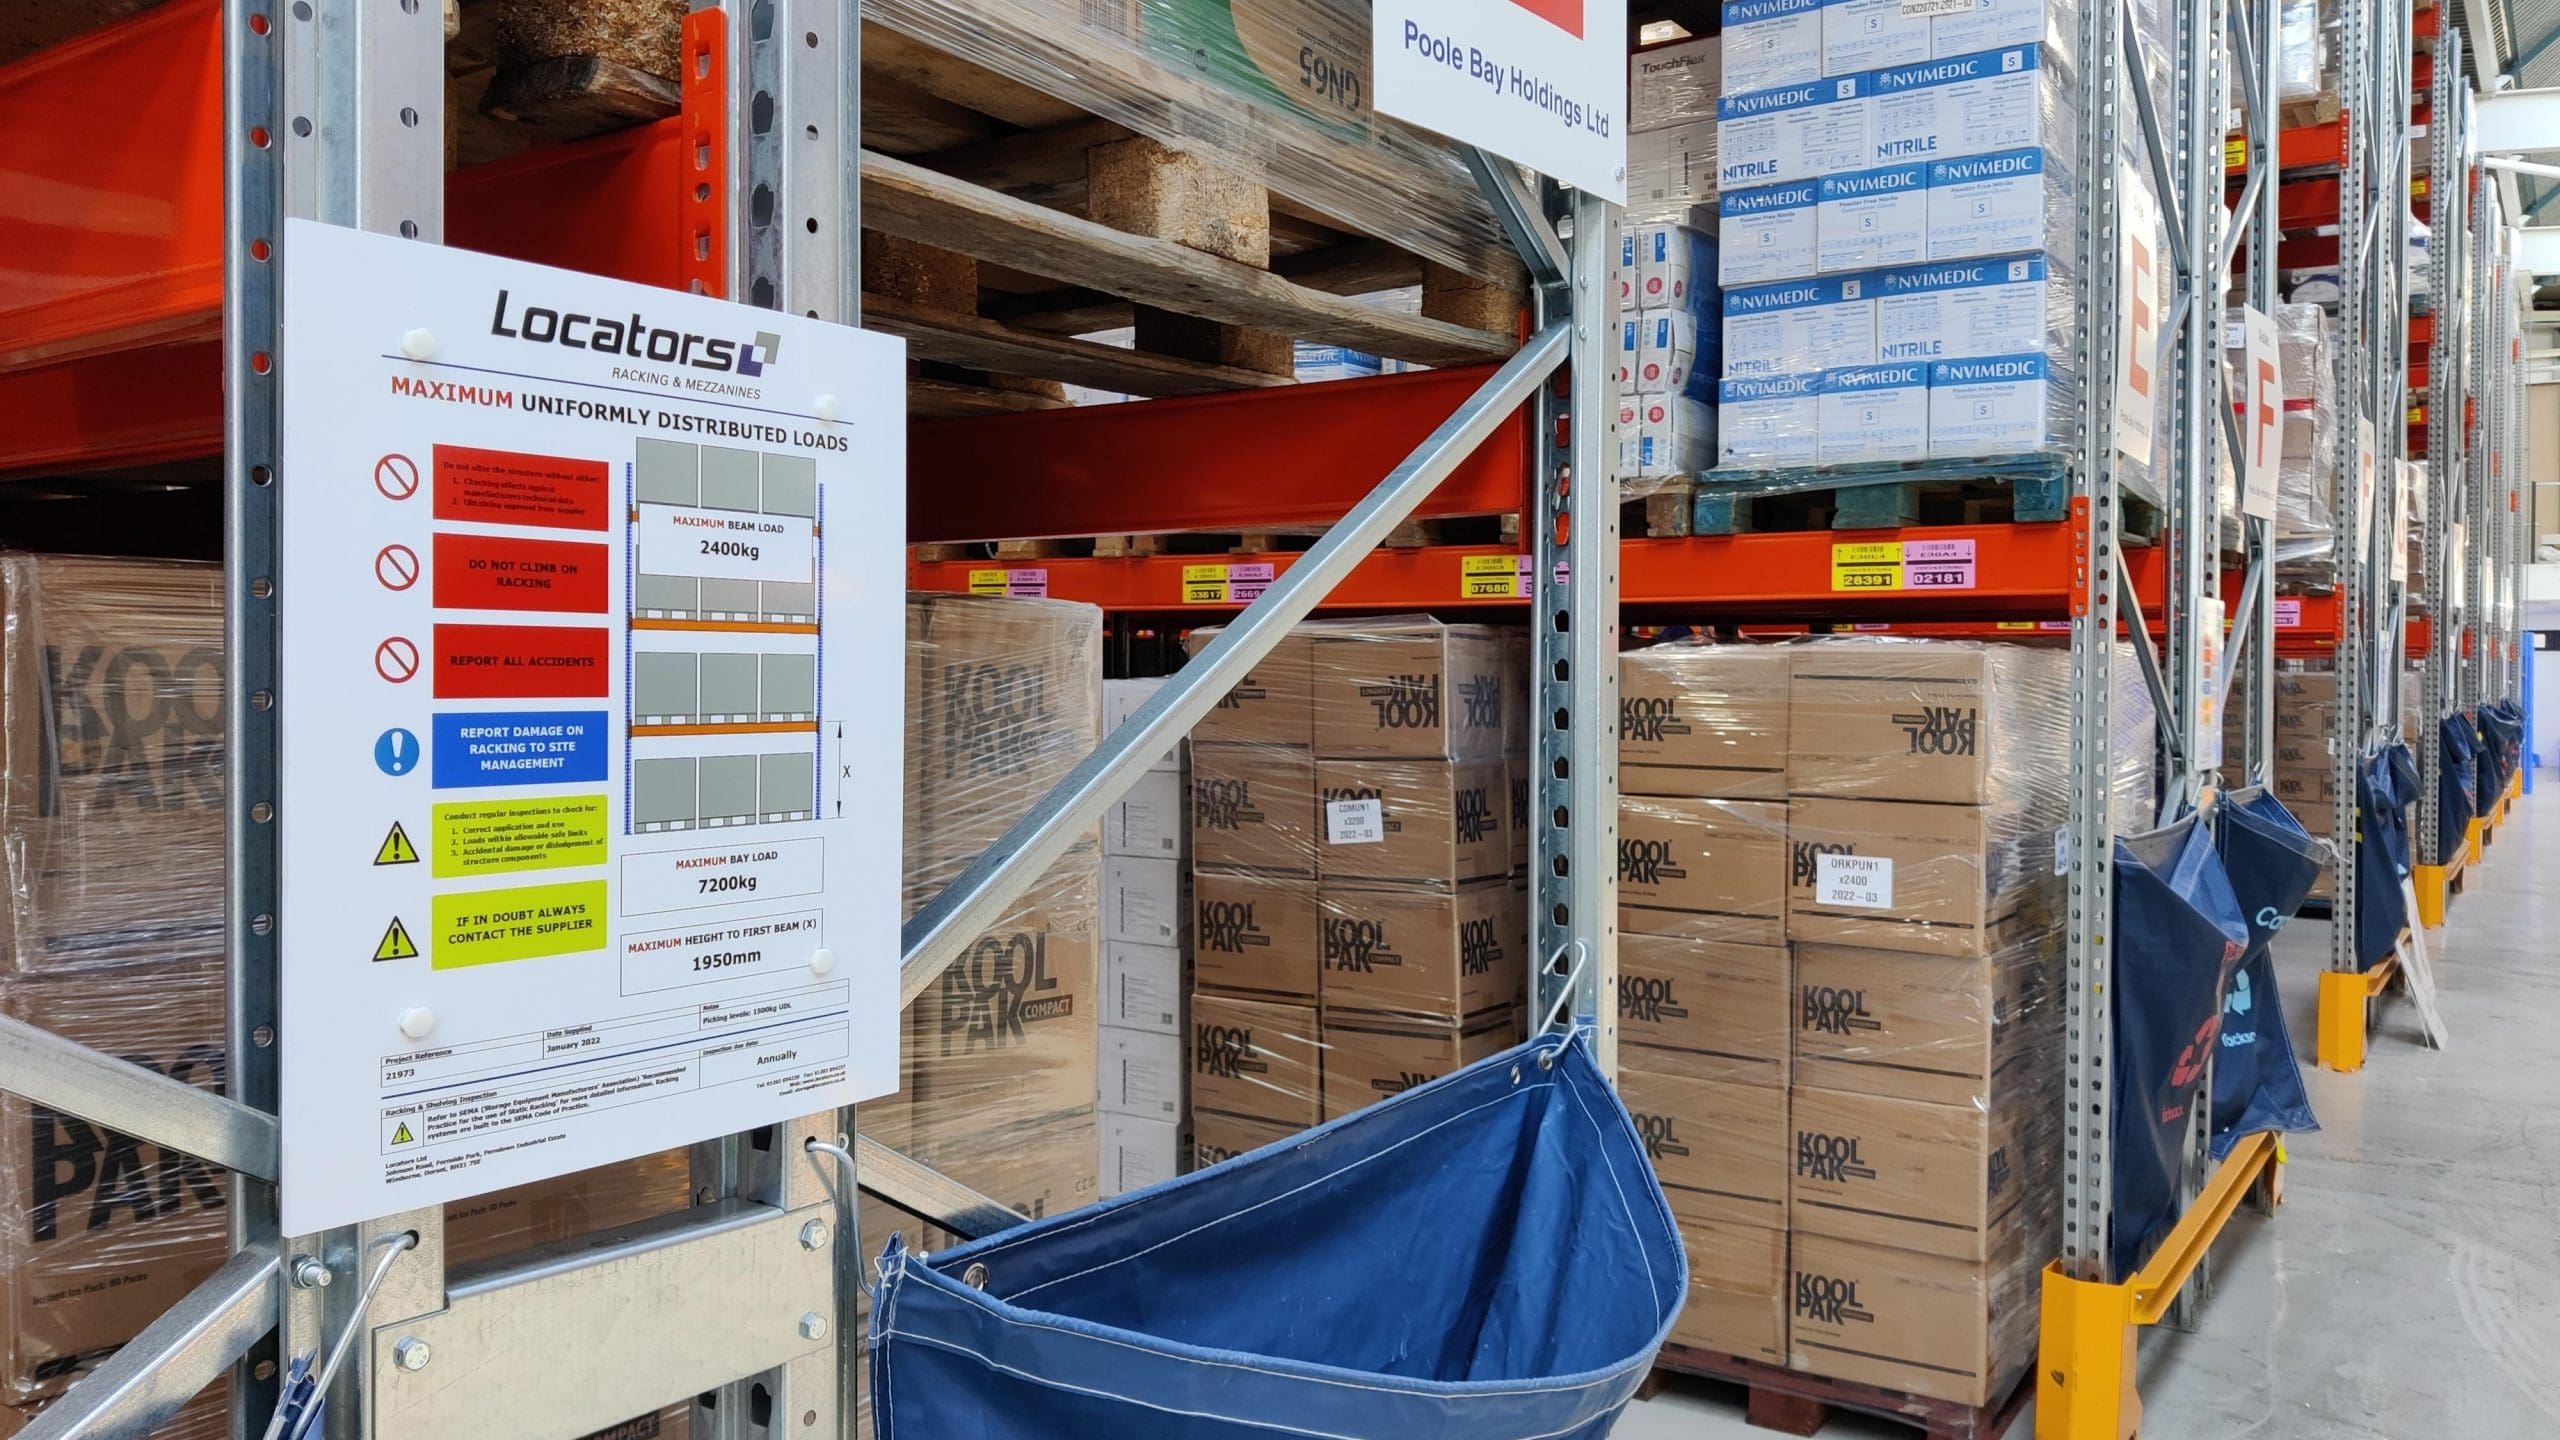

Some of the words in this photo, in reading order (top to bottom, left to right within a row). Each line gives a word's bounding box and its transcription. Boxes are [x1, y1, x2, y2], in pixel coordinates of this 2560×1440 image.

[1641, 53, 1706, 74] TouchFlex
[1893, 60, 1978, 88] NVIMEDIC
[1299, 46, 1360, 112] GN65
[1404, 19, 1463, 70] Poole
[1470, 47, 1504, 94] Bay
[1510, 65, 1581, 127] Holdings
[1587, 103, 1609, 139] Ltd
[1737, 87, 1816, 112] NVIMEDIC
[1877, 135, 1937, 158] NITRILE
[1723, 158, 1778, 181] NITRILE
[1948, 155, 2033, 180] NVIMEDIC
[1836, 171, 1917, 195] NVIMEDIC
[1737, 188, 1813, 211] NVIMEDIC
[1898, 267, 1984, 290] NVIMEDIC
[1742, 287, 1820, 310] NVIMEDIC
[2130, 234, 2149, 398] E
[491, 289, 736, 373] Locators
[1882, 339, 1942, 360] NITRILE
[1838, 367, 1918, 389] NVIMEDIC
[1950, 360, 2035, 381] NVIMEDIC
[612, 366, 668, 386] RACKING
[672, 375, 681, 388] &
[685, 377, 761, 400] MEZZANINES
[392, 375, 512, 409] MAXIMUM
[522, 392, 650, 426] UNIFORMLY
[658, 411, 787, 444] DISTRIBUTED
[793, 430, 848, 452] LOADS
[2256, 359, 2275, 468] F
[673, 515, 724, 529] MAXIMUM
[727, 520, 755, 531] BEAM
[758, 522, 784, 534] LOAD
[700, 539, 759, 561] 2400kg
[468, 558, 487, 569] DO
[490, 559, 515, 571] NOT
[519, 561, 557, 573] CLIMB
[560, 564, 577, 574] ON
[496, 576, 551, 588] RACKING
[1471, 584, 1509, 593] 07680
[1844, 575, 1891, 586] 28391
[1914, 572, 1964, 584] 02181
[450, 655, 499, 666] REPORT
[503, 656, 524, 666] ALL
[528, 656, 594, 667] ACCIDENTS
[1619, 697, 1681, 722] KOOL
[1922, 706, 1977, 734] PAK
[460, 726, 509, 738] REPORT
[513, 725, 563, 737] DAMAGE
[566, 725, 583, 735] ON
[1619, 715, 1665, 742] PAK
[469, 742, 526, 754] RACKING
[529, 742, 545, 753] TO
[548, 741, 576, 752] SITE
[1903, 728, 1976, 756] KOOL
[480, 757, 565, 770] MANAGEMENT
[842, 764, 851, 778] X
[1338, 803, 1370, 813] COMUN1
[675, 856, 726, 869] MAXIMUM
[730, 853, 749, 864] BAY
[752, 850, 778, 862] LOAD
[1831, 858, 1878, 871] ORKPUN1
[698, 873, 756, 897] 7200kg
[1839, 875, 1867, 886] x2400
[456, 916, 469, 927] IF
[473, 914, 487, 925] IN
[492, 909, 534, 923] DOUBT
[537, 903, 585, 918] ALWAYS
[1201, 901, 1260, 932] KOOL
[448, 928, 505, 944] CONTACT
[509, 925, 532, 937] THE
[536, 918, 592, 934] SUPPLIER
[628, 937, 681, 953] MAXIMUM
[685, 931, 724, 945] HEIGHT
[726, 929, 740, 940] TO
[743, 925, 771, 937] FIRST
[774, 921, 799, 933] BEAM
[802, 918, 816, 931] (X)
[1201, 926, 1244, 953] PAK
[1324, 918, 1391, 950] KOOL
[693, 947, 760, 971] 1950mm
[943, 932, 1057, 1000] KOOL
[1324, 943, 1373, 973] PAK
[702, 1013, 728, 1026] Picking
[729, 1009, 751, 1020] levels:
[753, 1004, 777, 1016] 1500kg
[1024, 997, 1071, 1019] COMPACT
[546, 1029, 562, 1038] Date
[563, 1024, 592, 1035] Supplied
[941, 988, 1027, 1057] PAK
[385, 1054, 412, 1066] Project
[414, 1047, 452, 1061] Reference
[546, 1040, 579, 1054] January
[580, 1036, 600, 1046] 2022
[756, 1048, 797, 1067] Annually
[386, 1068, 415, 1081] 21973
[385, 1105, 416, 1118] Racking
[417, 1103, 423, 1111] &
[425, 1097, 457, 1110] Shelving
[459, 1089, 497, 1104] Inspection
[1796, 1271, 1863, 1308] KOOL
[1796, 1297, 1844, 1325] PAK
